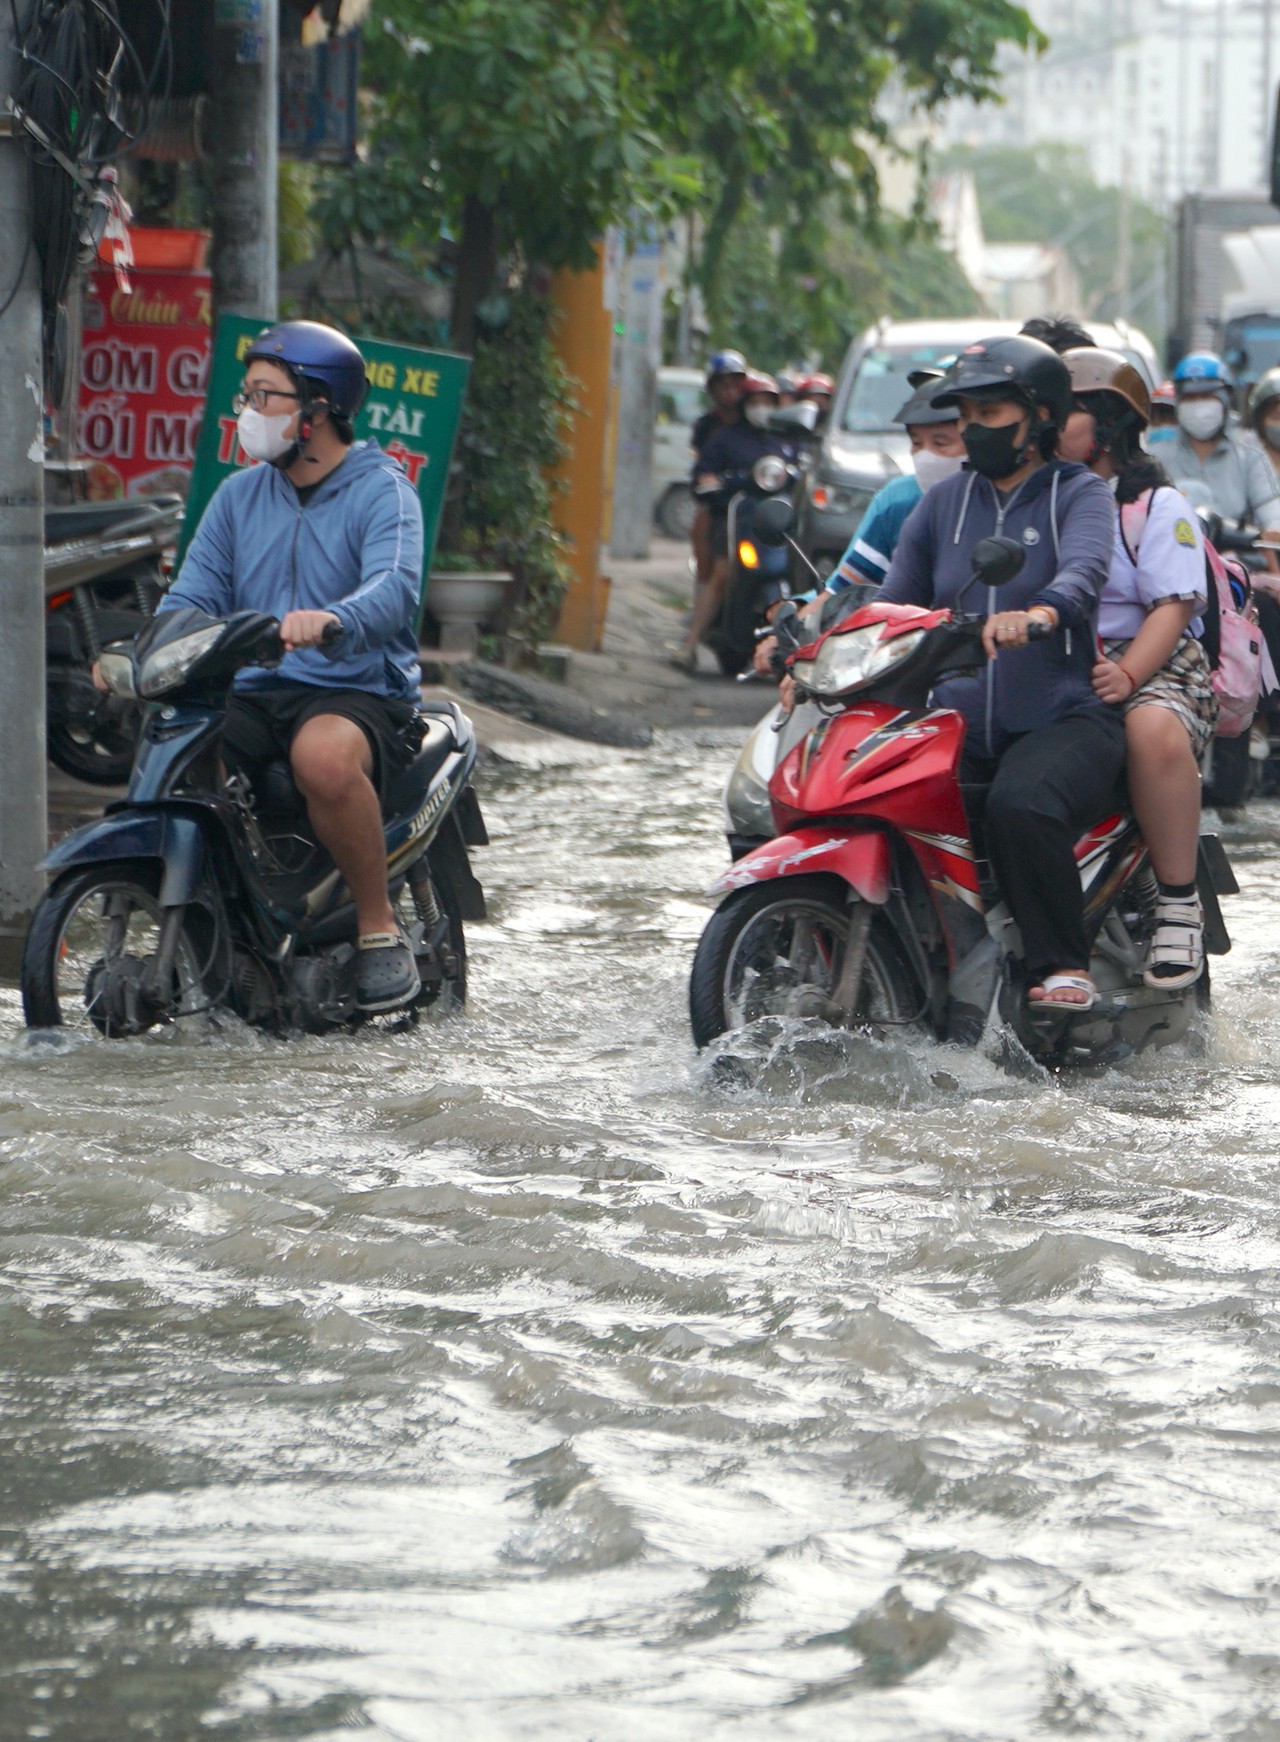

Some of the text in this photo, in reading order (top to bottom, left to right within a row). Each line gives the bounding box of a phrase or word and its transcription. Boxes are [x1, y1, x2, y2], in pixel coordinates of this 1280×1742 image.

[80, 336, 158, 395] ƠM
[401, 366, 440, 397] XE
[408, 777, 452, 840] JUPITER
